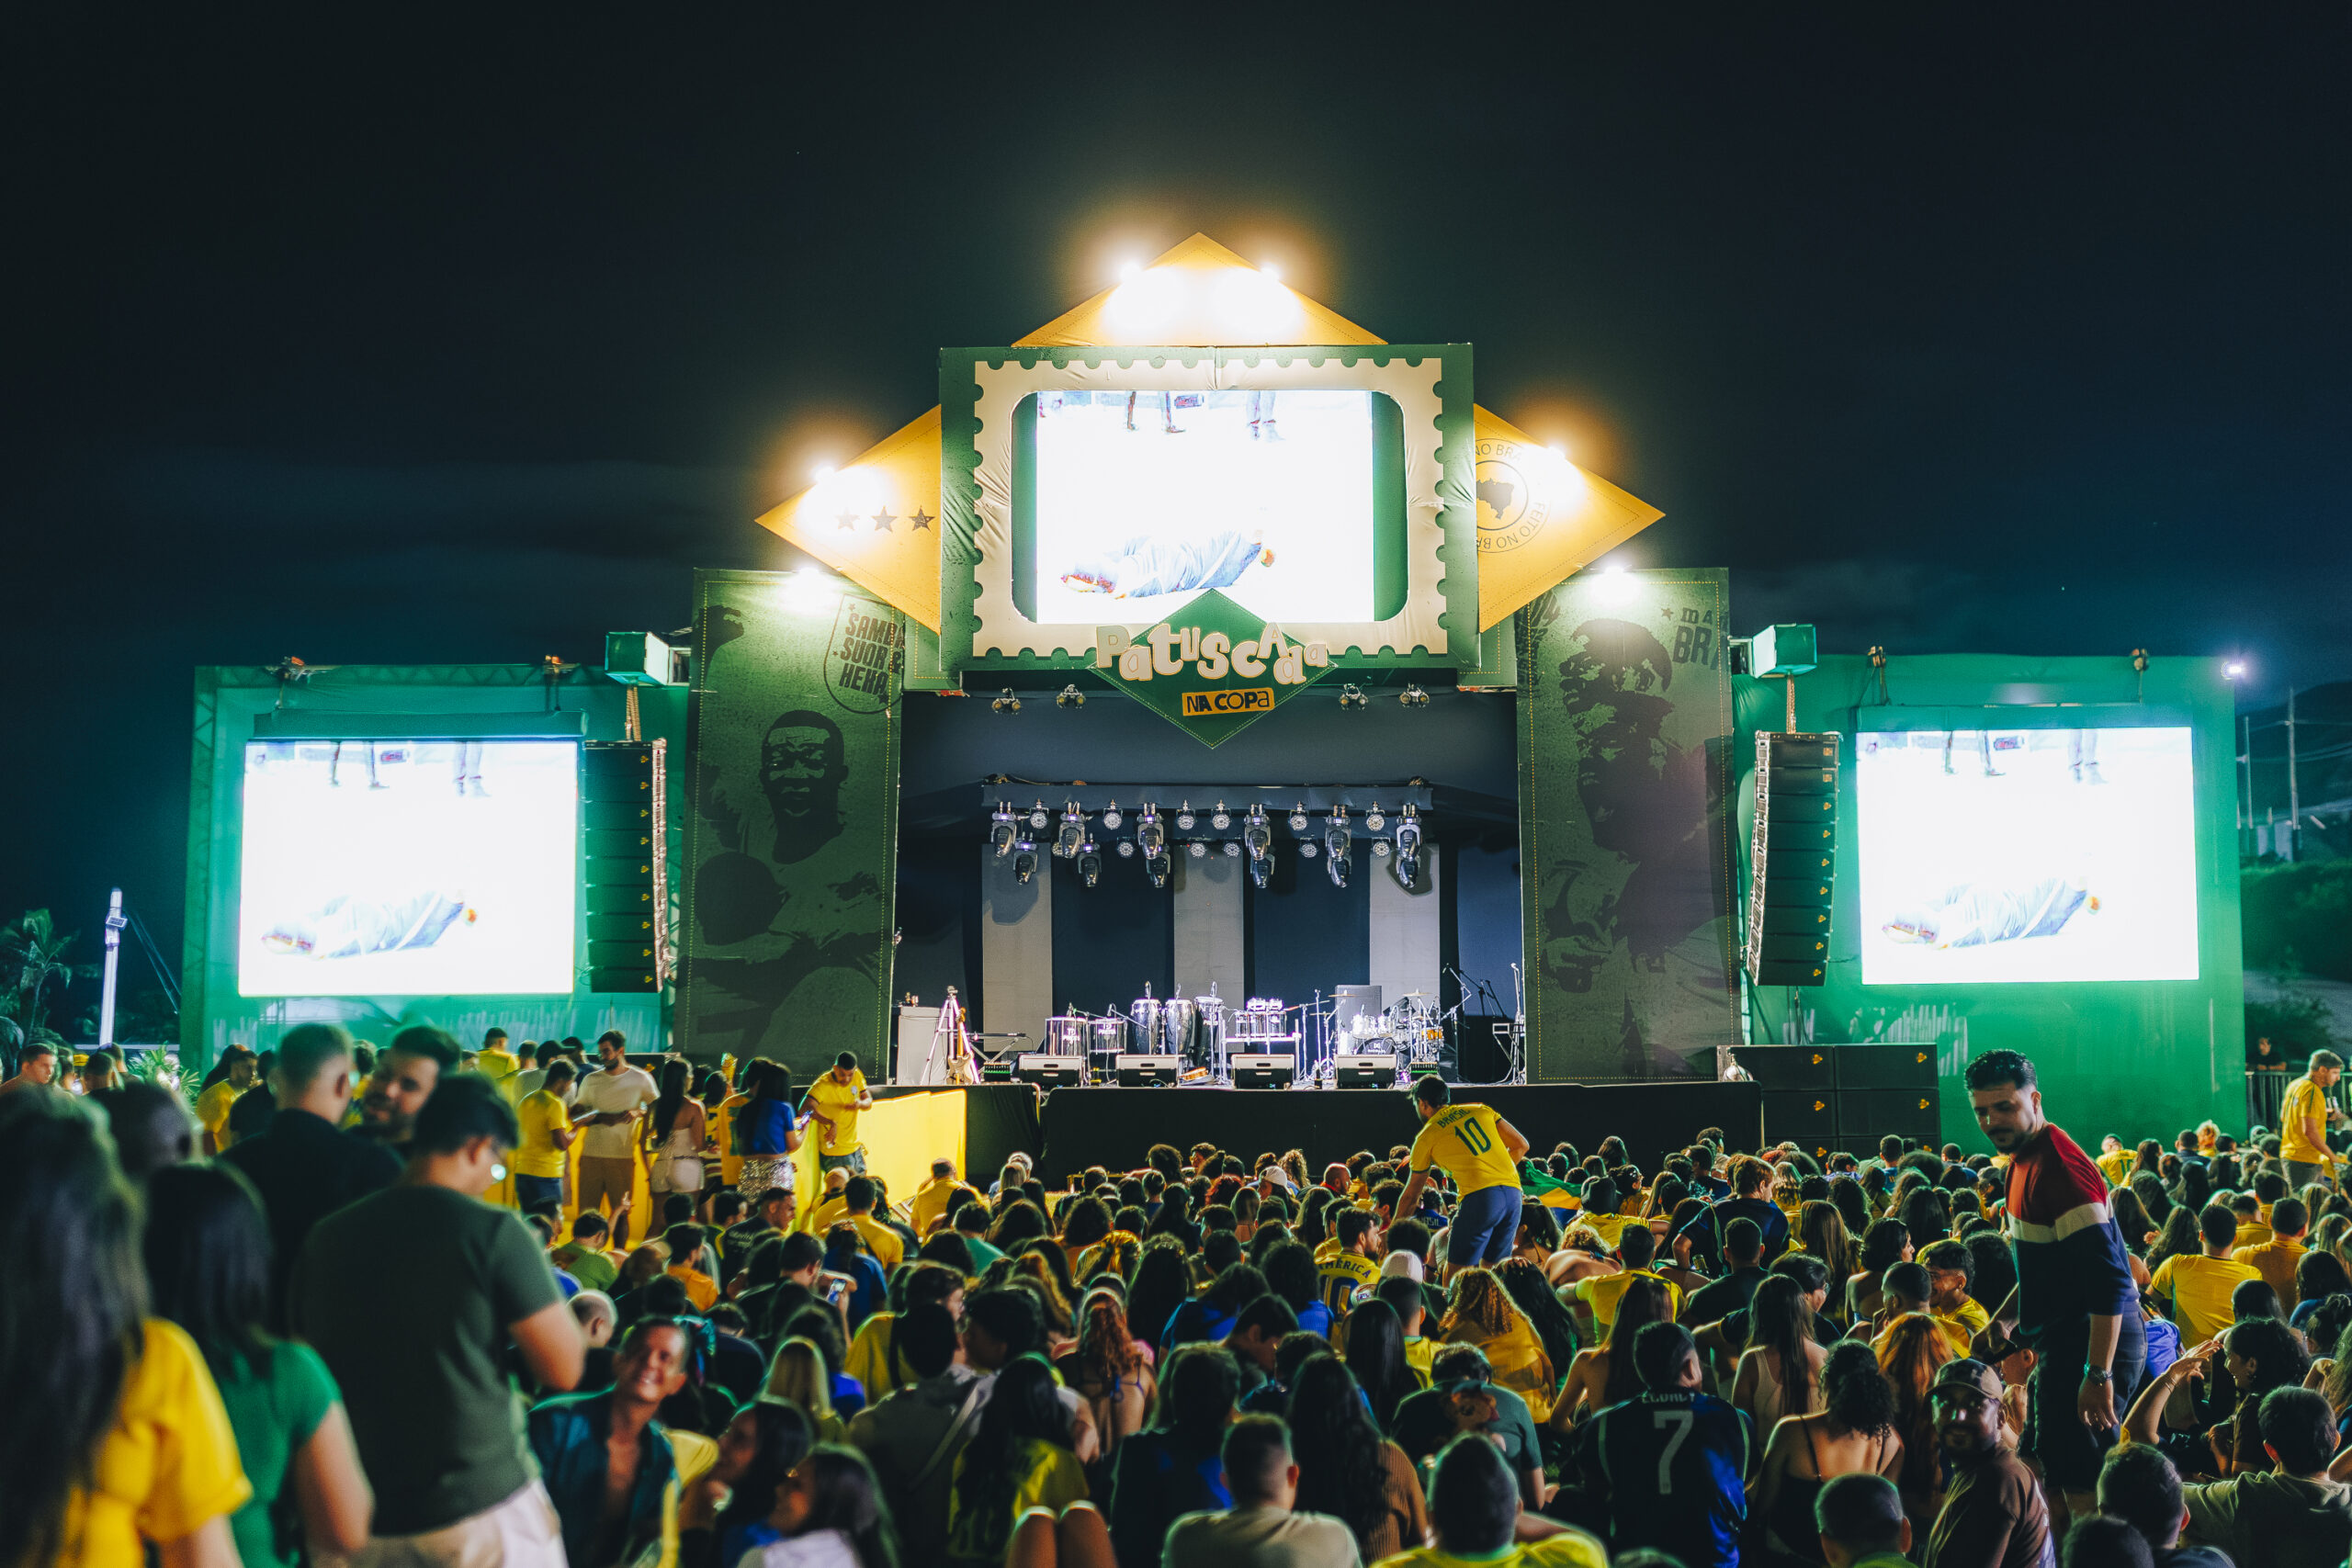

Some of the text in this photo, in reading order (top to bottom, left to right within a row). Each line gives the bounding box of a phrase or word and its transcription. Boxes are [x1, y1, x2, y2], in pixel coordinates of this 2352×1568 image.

[1519, 502, 1546, 537] FEITO
[1496, 533, 1519, 549] NO
[845, 613, 905, 649] SAMBA
[840, 637, 888, 671] SUOR
[1186, 694, 1212, 713] NA
[1437, 1108, 1471, 1129] BRASIL
[1453, 1116, 1492, 1156] 10
[1654, 1410, 1694, 1495] 7
